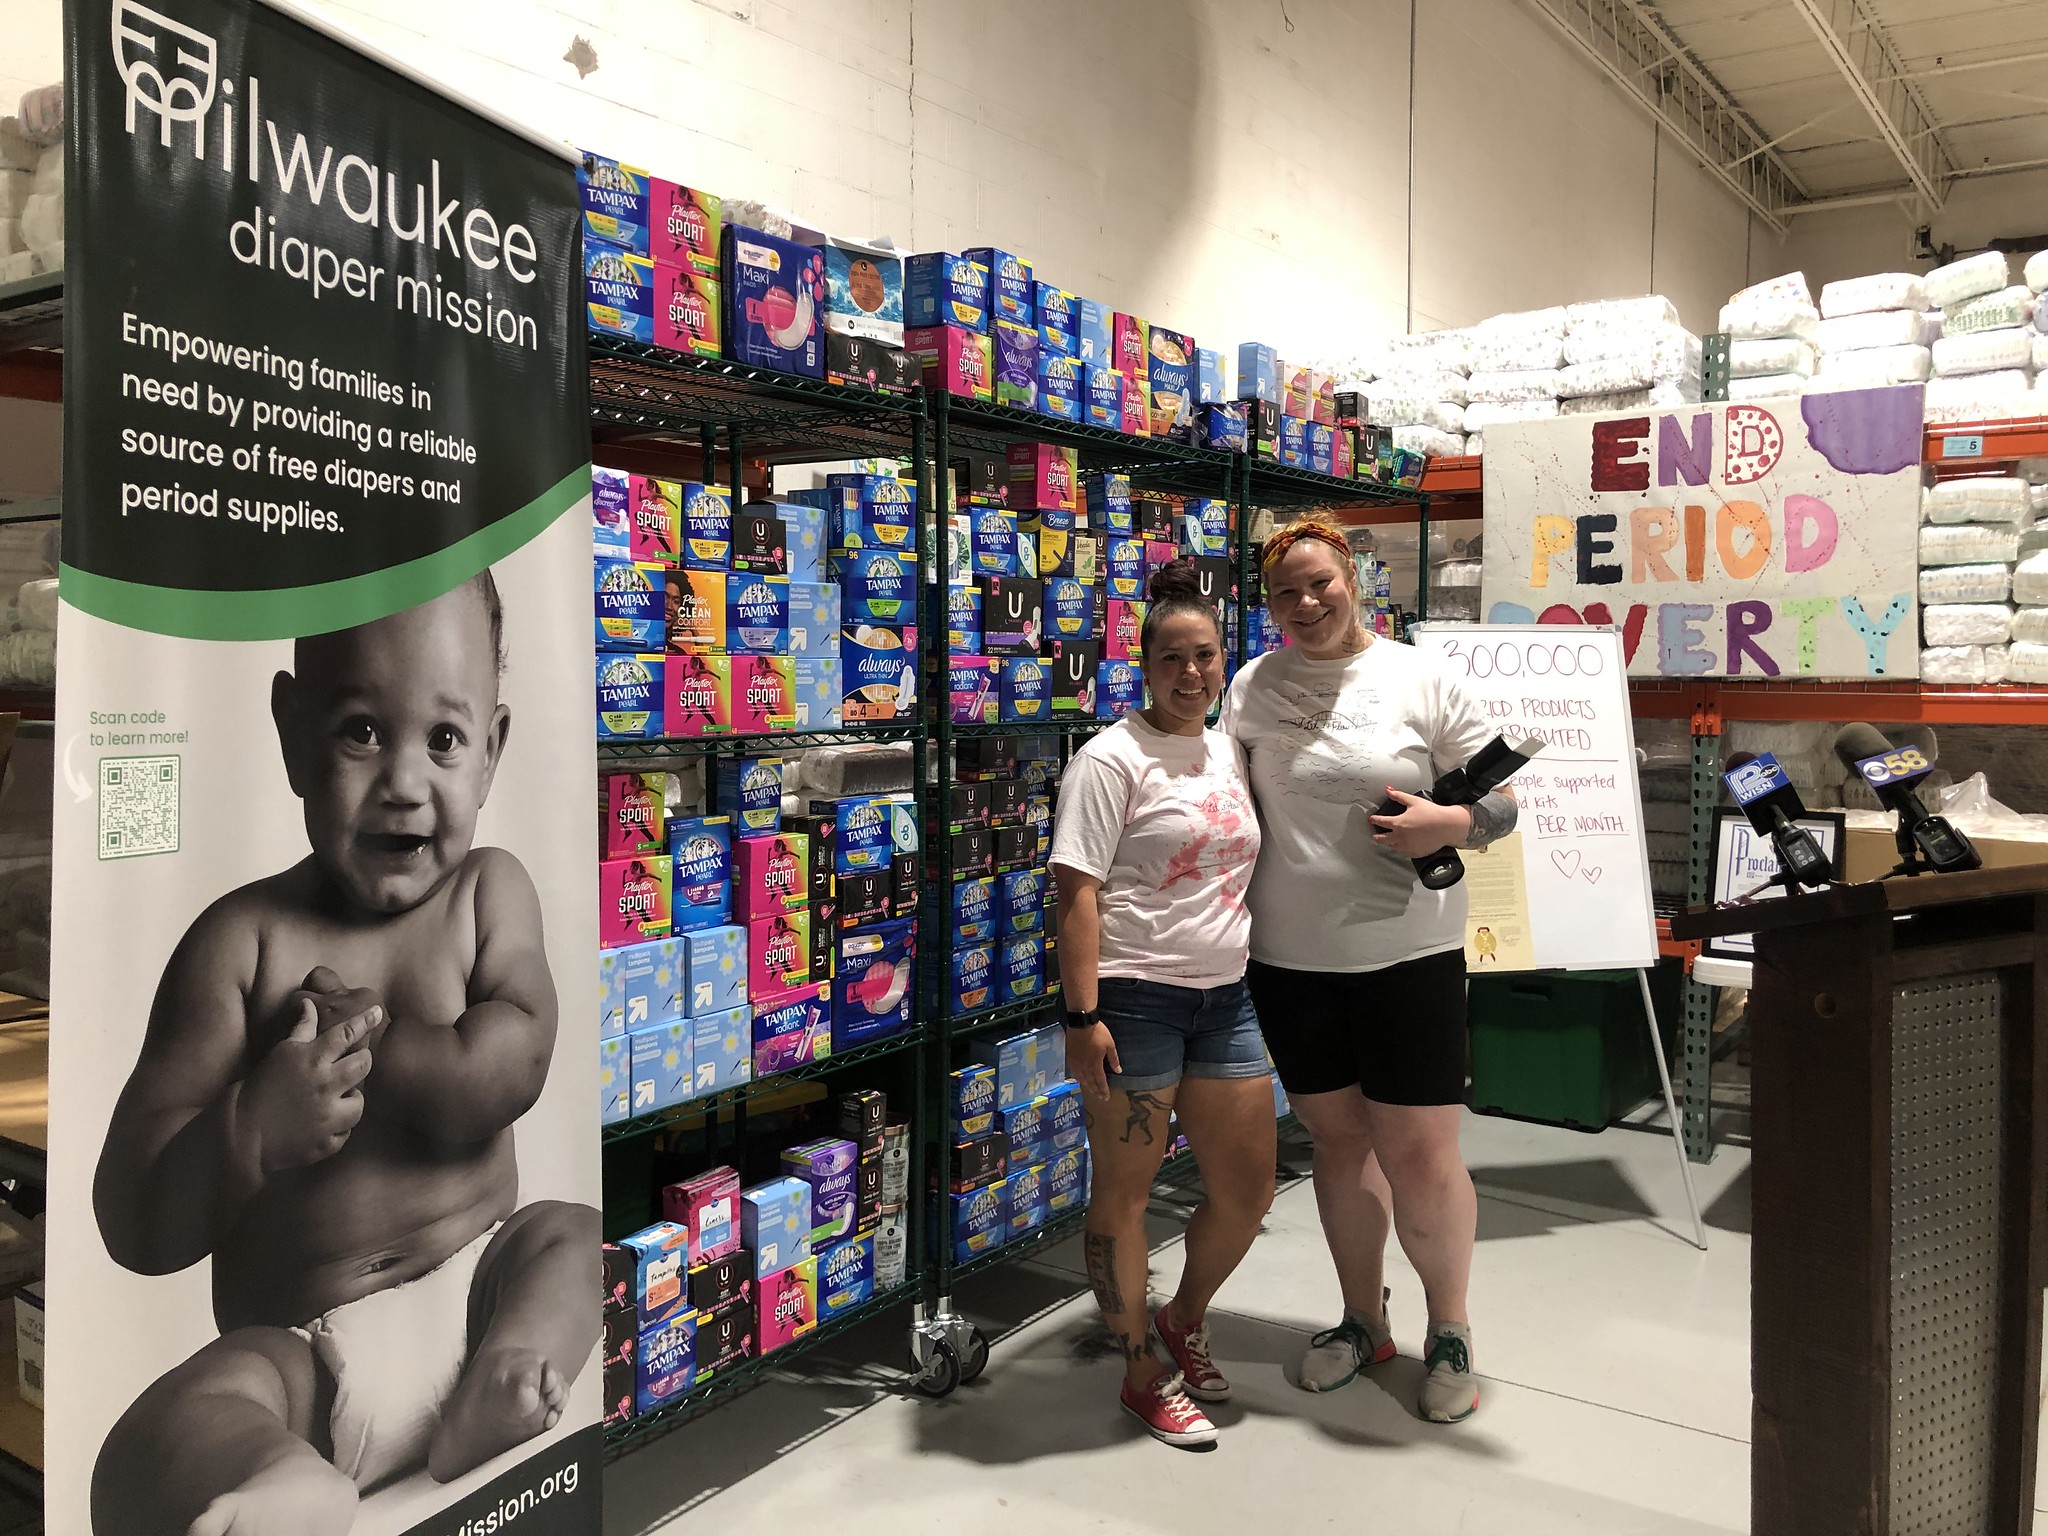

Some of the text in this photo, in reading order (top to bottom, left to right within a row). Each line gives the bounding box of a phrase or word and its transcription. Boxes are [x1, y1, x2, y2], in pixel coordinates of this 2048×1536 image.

[587, 189, 637, 209] TAMPAX
[672, 205, 701, 223] Playtex
[668, 217, 705, 242] SPORT
[231, 207, 538, 350] diaper mission
[743, 266, 769, 284] Maxi
[590, 281, 638, 300] TAMPAX
[951, 283, 981, 298] TAMPAX
[1001, 278, 1026, 293] TAMPAX
[673, 292, 701, 309] Playtex
[669, 305, 706, 327] SPORT
[1046, 310, 1068, 324] TAMPAX
[1124, 341, 1141, 355] SPORT
[123, 313, 431, 410] Empowering families in
[959, 358, 983, 376] SPORT
[1006, 351, 1032, 368] always
[1048, 379, 1073, 390] TAMPAX
[1154, 367, 1188, 390] always
[1091, 390, 1117, 400] TAMPAX
[123, 372, 477, 464] need by providing a reliable
[1125, 403, 1143, 416] SPORT
[1267, 408, 1274, 426] U
[1285, 437, 1302, 445] TAMPAX
[1591, 405, 1783, 492] END
[1969, 441, 1977, 450] 5
[122, 429, 460, 503] source of free diapers and
[1048, 473, 1068, 486] SPORT
[122, 479, 344, 533] period supplies.
[641, 500, 668, 514] Playtex
[873, 505, 909, 516] TAMPAX
[1108, 498, 1130, 506] TAMPAX
[637, 511, 672, 531] SPORT
[689, 519, 729, 530] TAMPAX
[1048, 514, 1069, 526] Breeze
[1203, 521, 1226, 529] TAMPAX
[979, 535, 1010, 544] TAMPAX
[1530, 494, 1839, 588] PERIOD
[849, 551, 858, 559] 96
[1114, 562, 1137, 571] TAMPAX
[866, 579, 901, 590] TAMPAX
[1201, 571, 1211, 595] U
[601, 593, 650, 607] TAMPAX
[683, 595, 708, 606] Playtex
[1009, 591, 1023, 618] U
[1057, 600, 1083, 610] TAMPAX
[678, 607, 710, 618] CLEAN
[737, 603, 779, 617] TAMPAX
[1117, 626, 1137, 637] SPORT
[859, 653, 905, 678] always
[1070, 653, 1084, 680] U
[1443, 640, 1603, 678] 300,000
[684, 678, 712, 692] Playtex
[751, 675, 778, 688] Playtex
[954, 681, 973, 690] radiant
[1014, 682, 1041, 692] TAMPAX
[1108, 683, 1133, 694] TAMPAX
[601, 686, 650, 702] TAMPAX
[680, 691, 717, 706] SPORT
[747, 689, 781, 703] SPORT
[90, 710, 166, 724] Scan code
[860, 705, 866, 716] 4
[1521, 698, 1595, 720] PRODUCTS
[91, 731, 189, 745] to learn more!
[1496, 724, 1591, 750] TRIBUTED
[1761, 766, 1778, 777] abc
[1884, 750, 1927, 776] 58
[1510, 774, 1614, 794] eople supported
[1730, 765, 1760, 794] 12
[743, 785, 780, 802] TAMPAX
[1741, 782, 1772, 800] WISN
[624, 796, 652, 806] Playtex
[620, 807, 655, 823] SPORT
[1536, 813, 1624, 833] PER MONTH
[847, 825, 881, 842] TAMPAX
[680, 857, 723, 877] TAMPAX
[769, 858, 793, 869] Playtex
[765, 869, 796, 887] SPORT
[624, 882, 653, 895] Playtex
[619, 893, 657, 913] SPORT
[961, 901, 989, 918] TAMPAX
[1012, 892, 1036, 910] TAMPAX
[769, 935, 793, 949] Playtex
[765, 945, 796, 965] SPORT
[847, 954, 871, 970] Maxi
[1010, 956, 1036, 974] TAMPAX
[961, 968, 988, 986] TAMPAX
[764, 1004, 807, 1028] TAMPAX
[776, 1020, 799, 1034] radiant
[961, 1095, 993, 1113] TAMPAX
[1054, 1109, 1080, 1128] TAMPAX
[1011, 1123, 1041, 1144] TAMPAX
[819, 1172, 851, 1195] always
[1051, 1172, 1077, 1191] TAMPAX
[1013, 1188, 1040, 1211] TAMPAX
[968, 1208, 997, 1231] TAMPAX
[826, 1260, 863, 1289] TAMPAX
[775, 1295, 805, 1321] SPORT
[647, 1341, 690, 1375] TAMPAX
